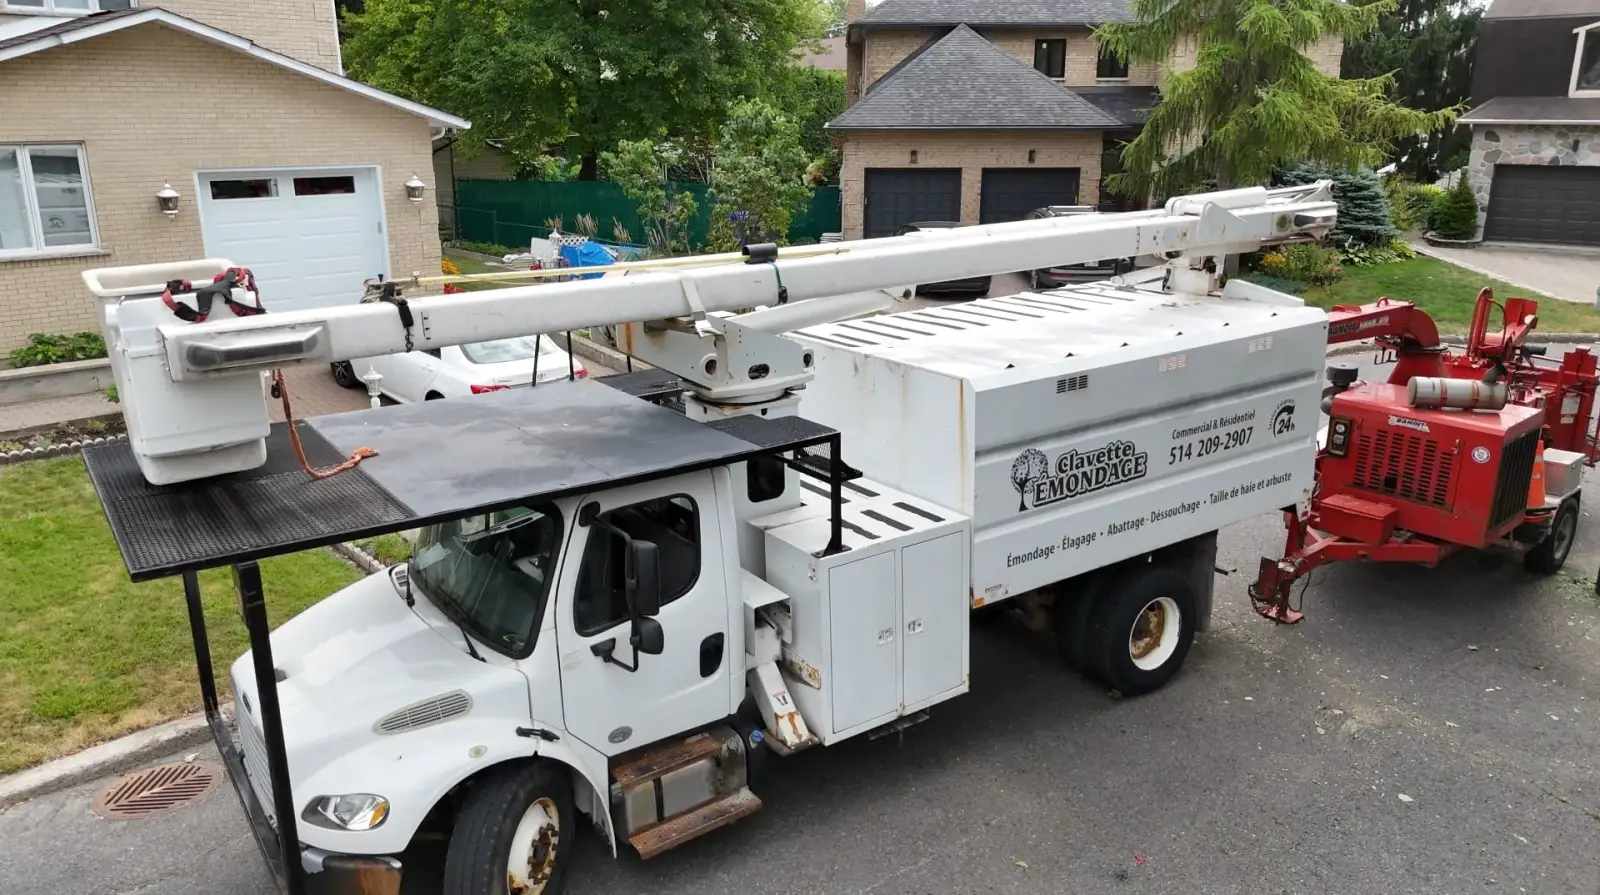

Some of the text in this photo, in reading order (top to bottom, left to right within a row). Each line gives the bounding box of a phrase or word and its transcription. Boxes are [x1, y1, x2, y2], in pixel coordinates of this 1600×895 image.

[1172, 408, 1256, 439] Commercial & Résidentiel
[1056, 442, 1134, 475] Clavette
[1168, 426, 1254, 465] 514 209-2907
[1033, 454, 1147, 504] ÉMONDAGE
[1006, 472, 1292, 568] Émondage Élagage Abattage Déssouchage Taille de haie et arbuste
